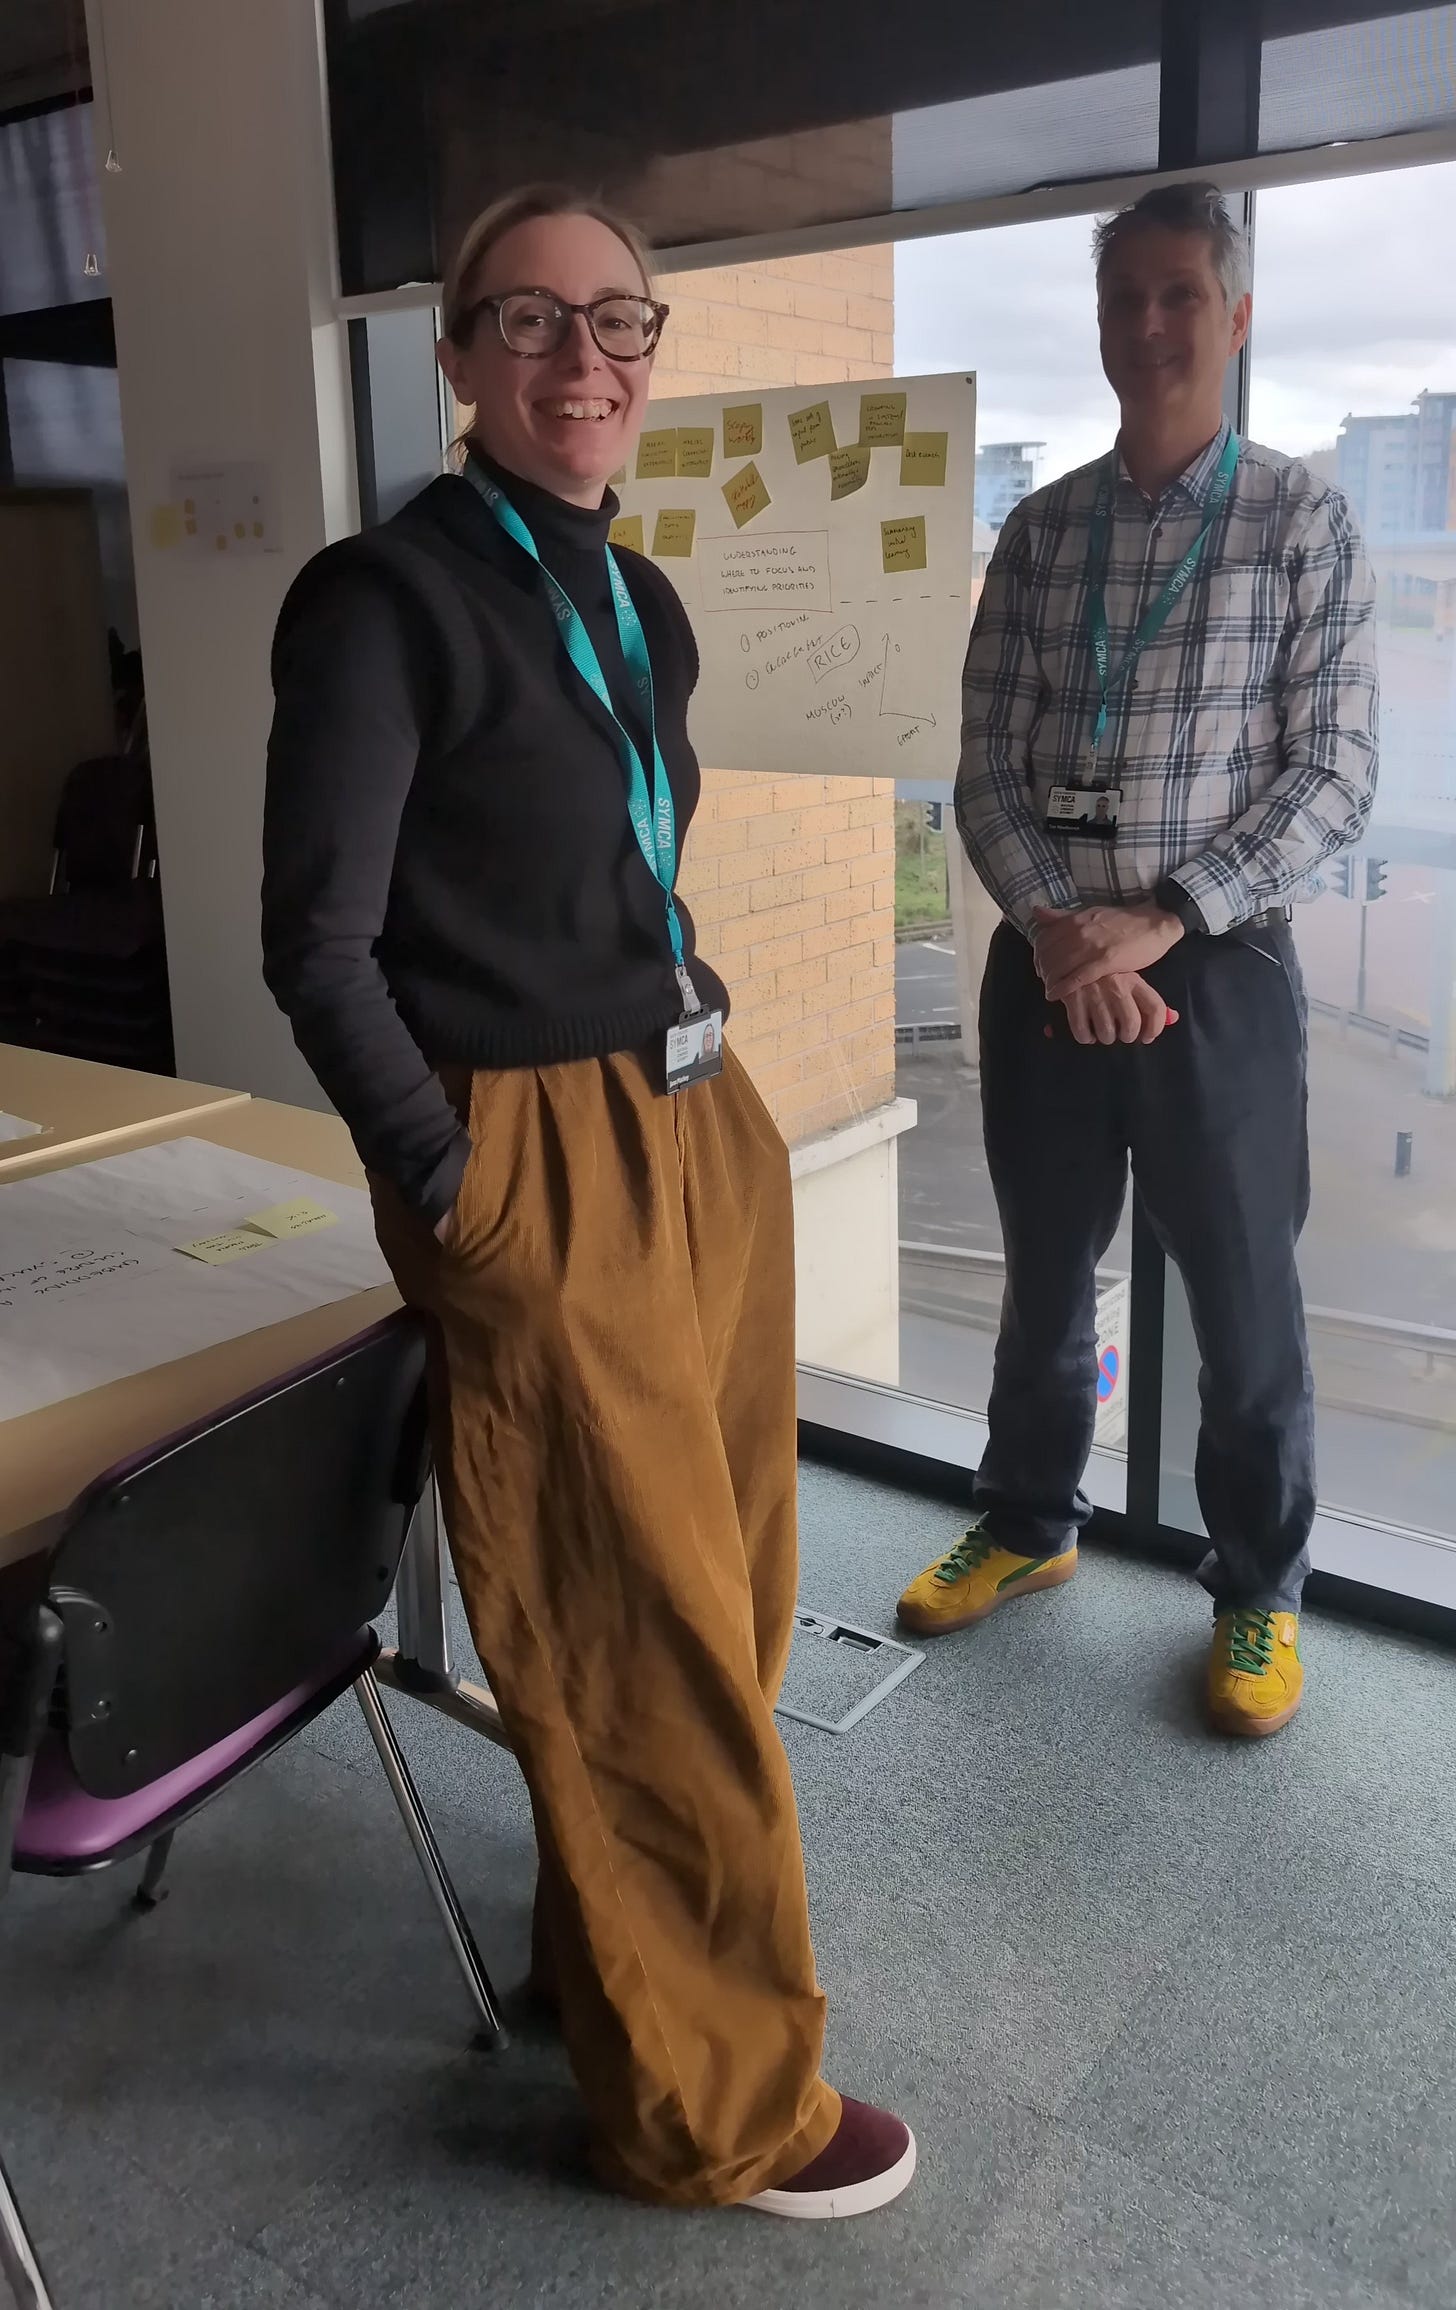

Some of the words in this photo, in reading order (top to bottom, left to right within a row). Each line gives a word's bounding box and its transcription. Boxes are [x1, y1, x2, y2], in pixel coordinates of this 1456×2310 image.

[1208, 471, 1230, 504] SYMCA
[723, 546, 797, 561] UNDERSTANDING
[610, 562, 631, 608] SYMCA
[721, 568, 745, 579] WHERE
[766, 565, 795, 575] FOCUS
[1168, 557, 1197, 593] SYMCA
[814, 636, 852, 671] RICE
[1094, 639, 1108, 676] SYMCA
[1052, 794, 1076, 804] SYMCA
[656, 797, 672, 849] SYMCA
